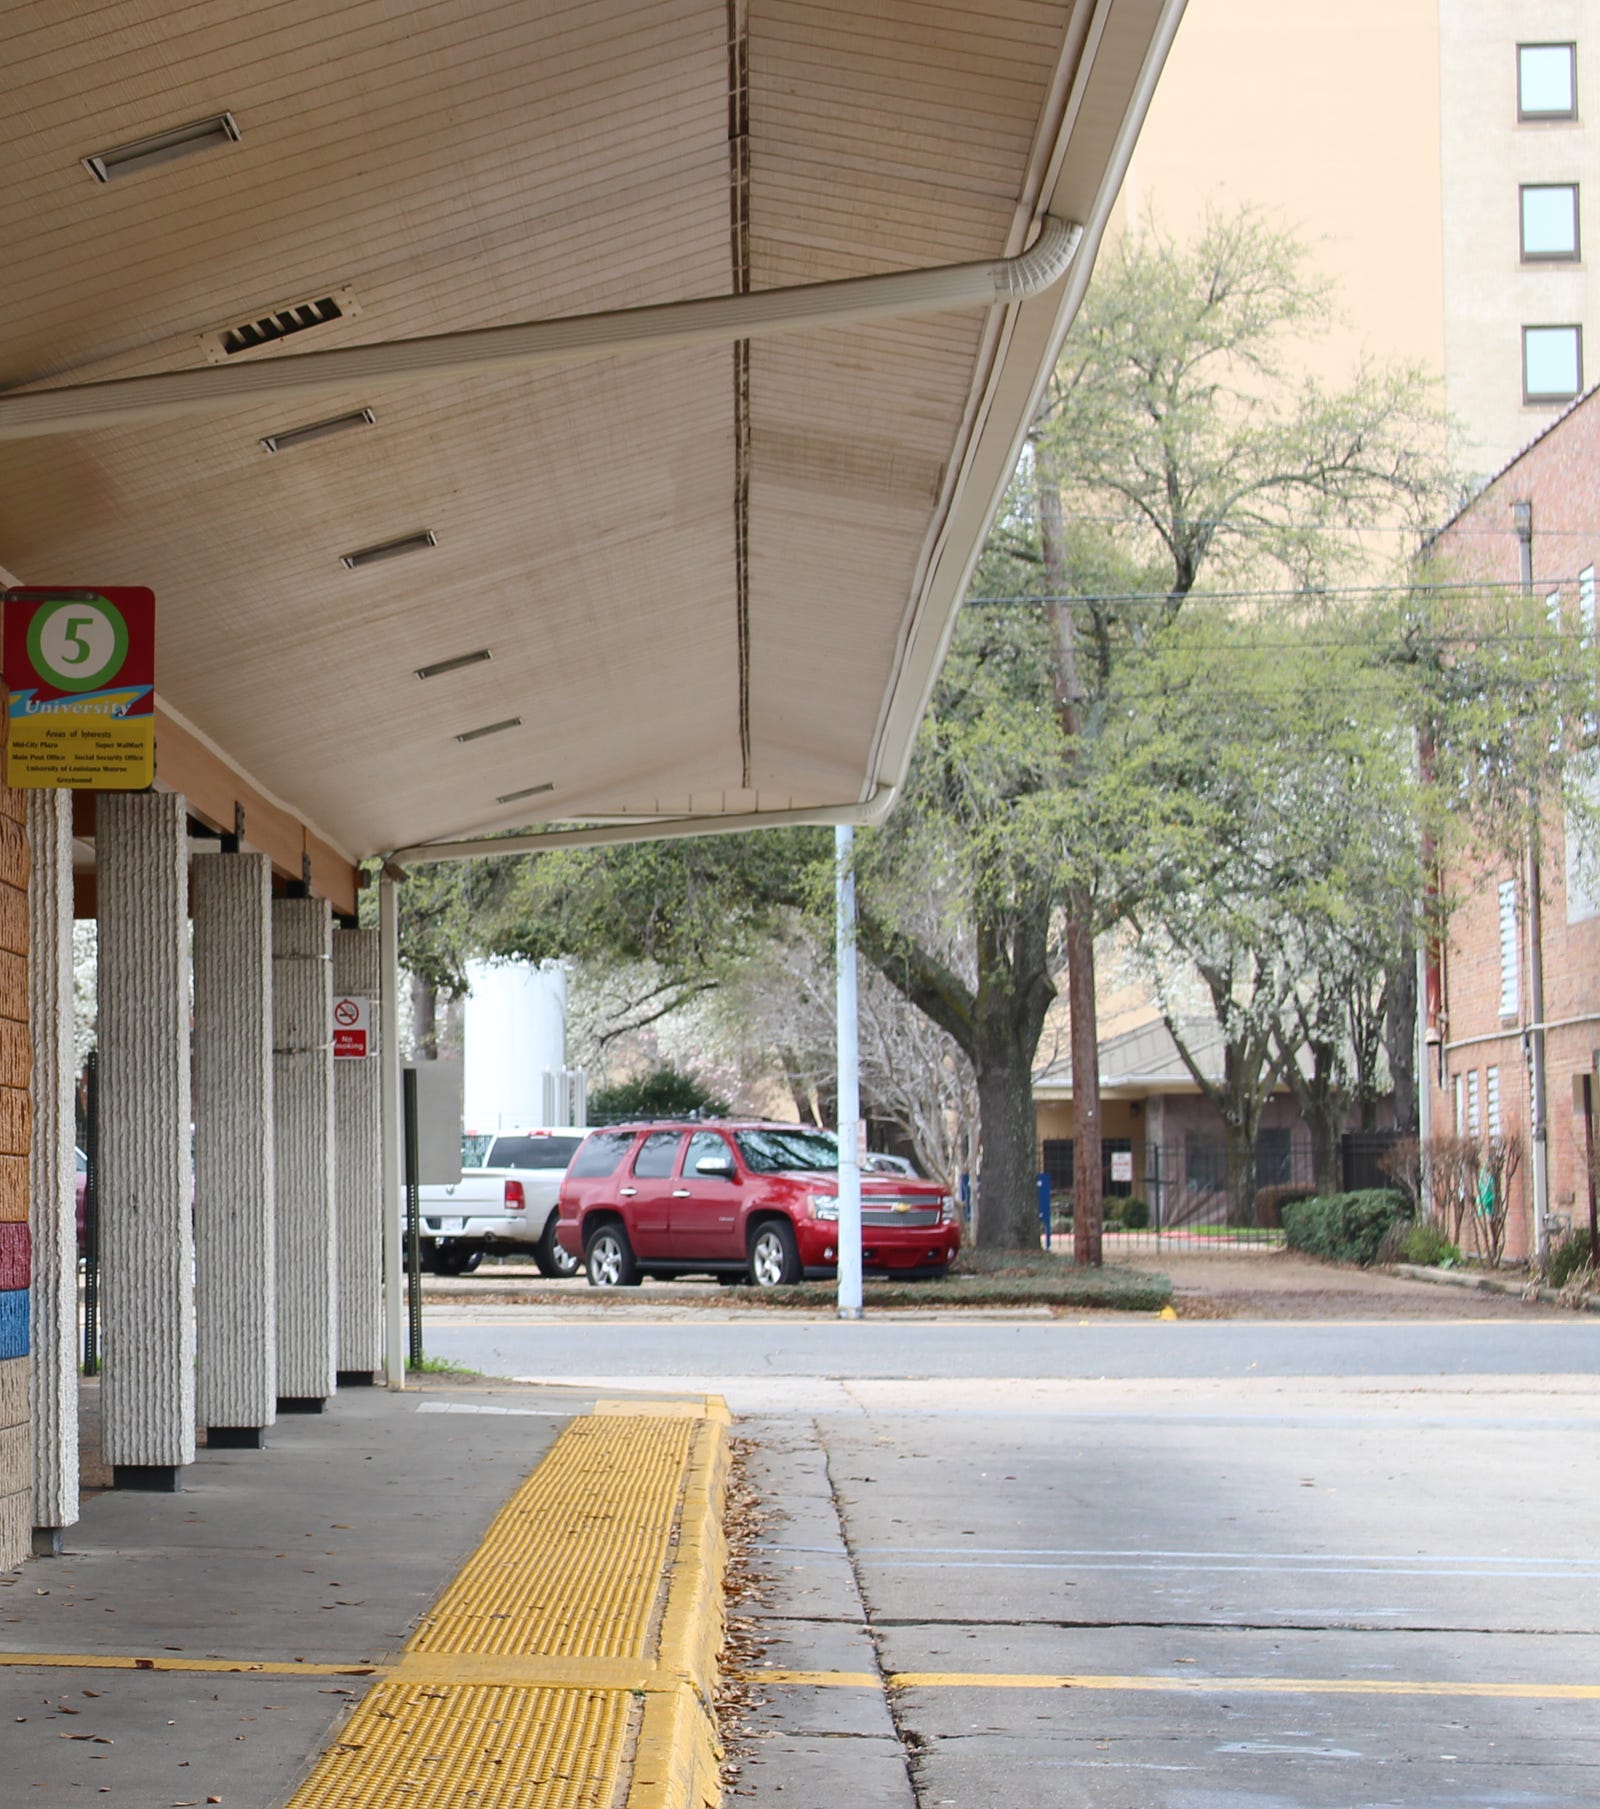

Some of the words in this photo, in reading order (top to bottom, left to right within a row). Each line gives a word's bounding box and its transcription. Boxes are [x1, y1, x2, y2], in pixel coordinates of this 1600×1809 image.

[61, 617, 94, 665] 5
[25, 699, 131, 717] University
[46, 729, 66, 738] Areas
[70, 729, 78, 738] of
[81, 729, 112, 739] Interests
